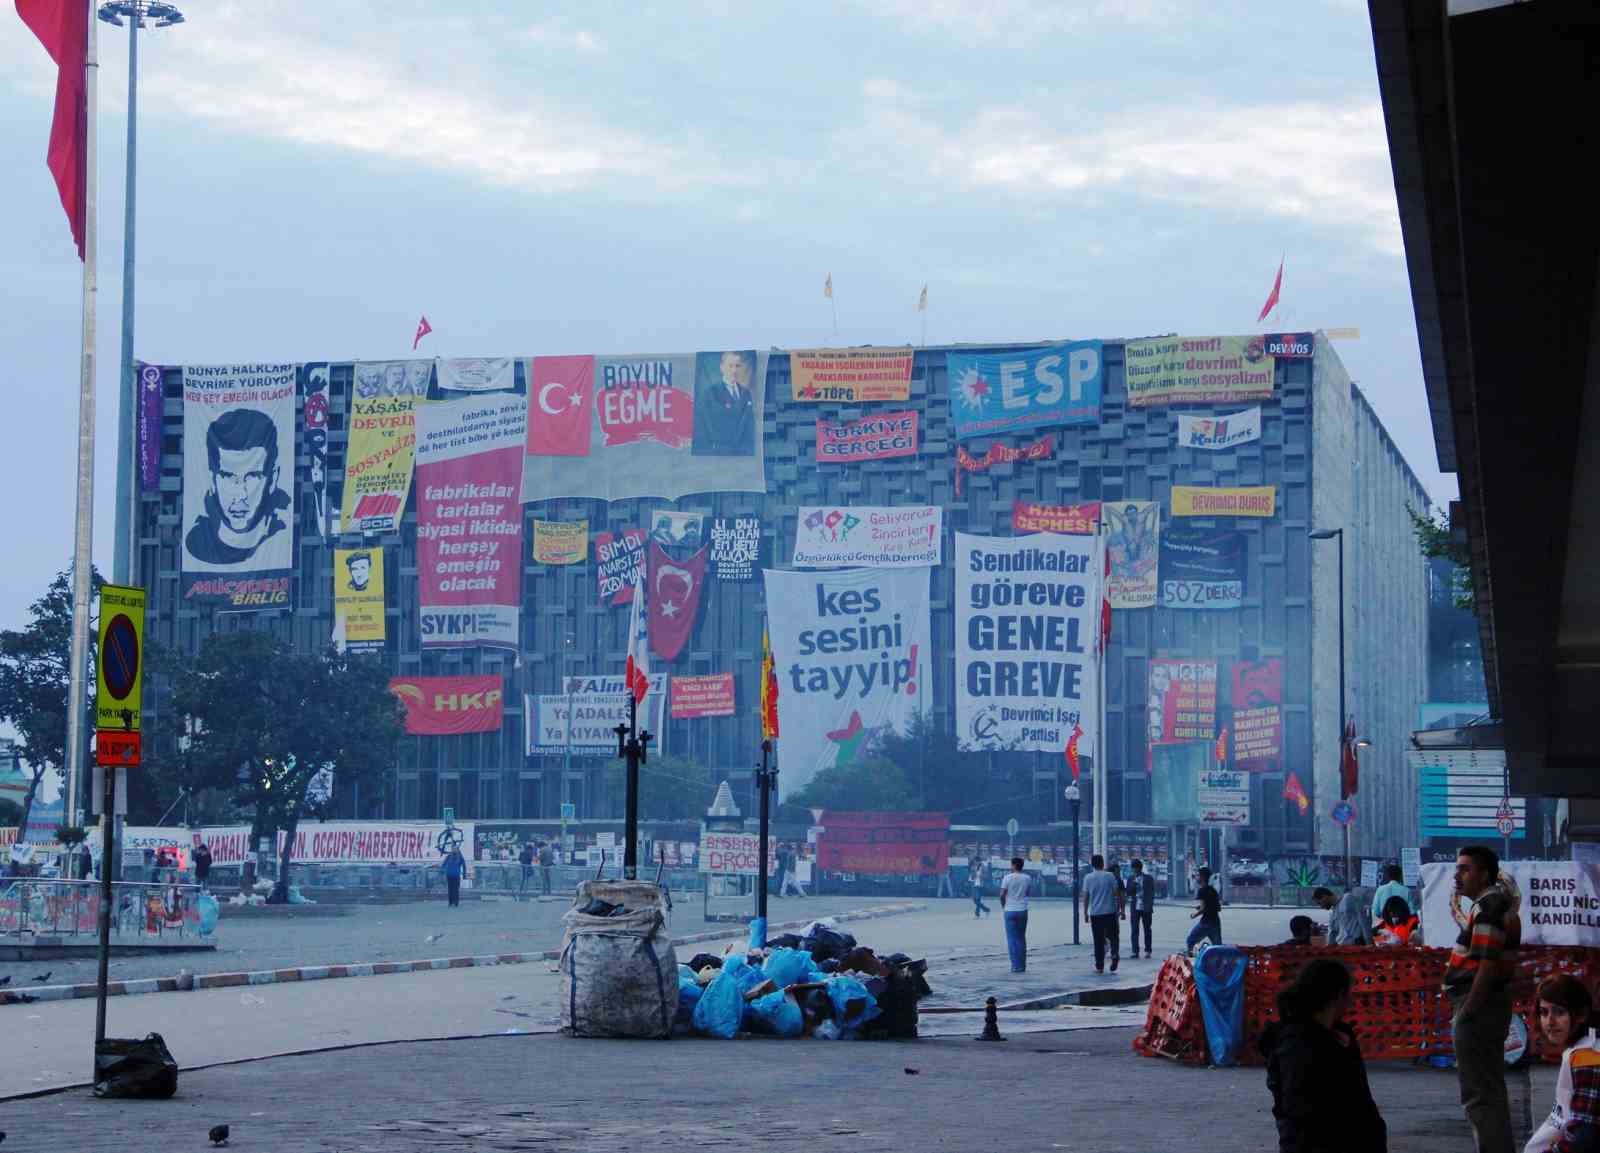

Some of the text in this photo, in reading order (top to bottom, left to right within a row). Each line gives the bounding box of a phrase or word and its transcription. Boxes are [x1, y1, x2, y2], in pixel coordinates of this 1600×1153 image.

[604, 361, 673, 390] BOYUN
[1000, 348, 1098, 410] ESP
[605, 388, 674, 425] EĞME
[425, 483, 514, 501] fabrikalar
[436, 502, 504, 518] tarlalar
[1029, 503, 1081, 517] HALK
[469, 520, 521, 536] iktidar
[438, 540, 499, 557] herşey
[436, 557, 500, 575] emeğin
[969, 548, 1090, 573] Sendikalar
[440, 576, 497, 592] olacak
[970, 577, 1086, 609] göreve
[816, 583, 881, 617] kes
[798, 612, 902, 656] sesini
[968, 614, 1085, 653] GENEL
[789, 644, 919, 699] tayyip!
[966, 660, 1083, 700] GREVE
[434, 690, 501, 712] HKP
[553, 707, 570, 720] Ya
[1001, 705, 1055, 723] Devrimci
[545, 728, 563, 740] Ya
[1021, 727, 1060, 744] Partisi
[312, 831, 354, 859] OCCUPY
[1530, 878, 1576, 894] BARIŞ
[1530, 895, 1570, 908] DOLU
